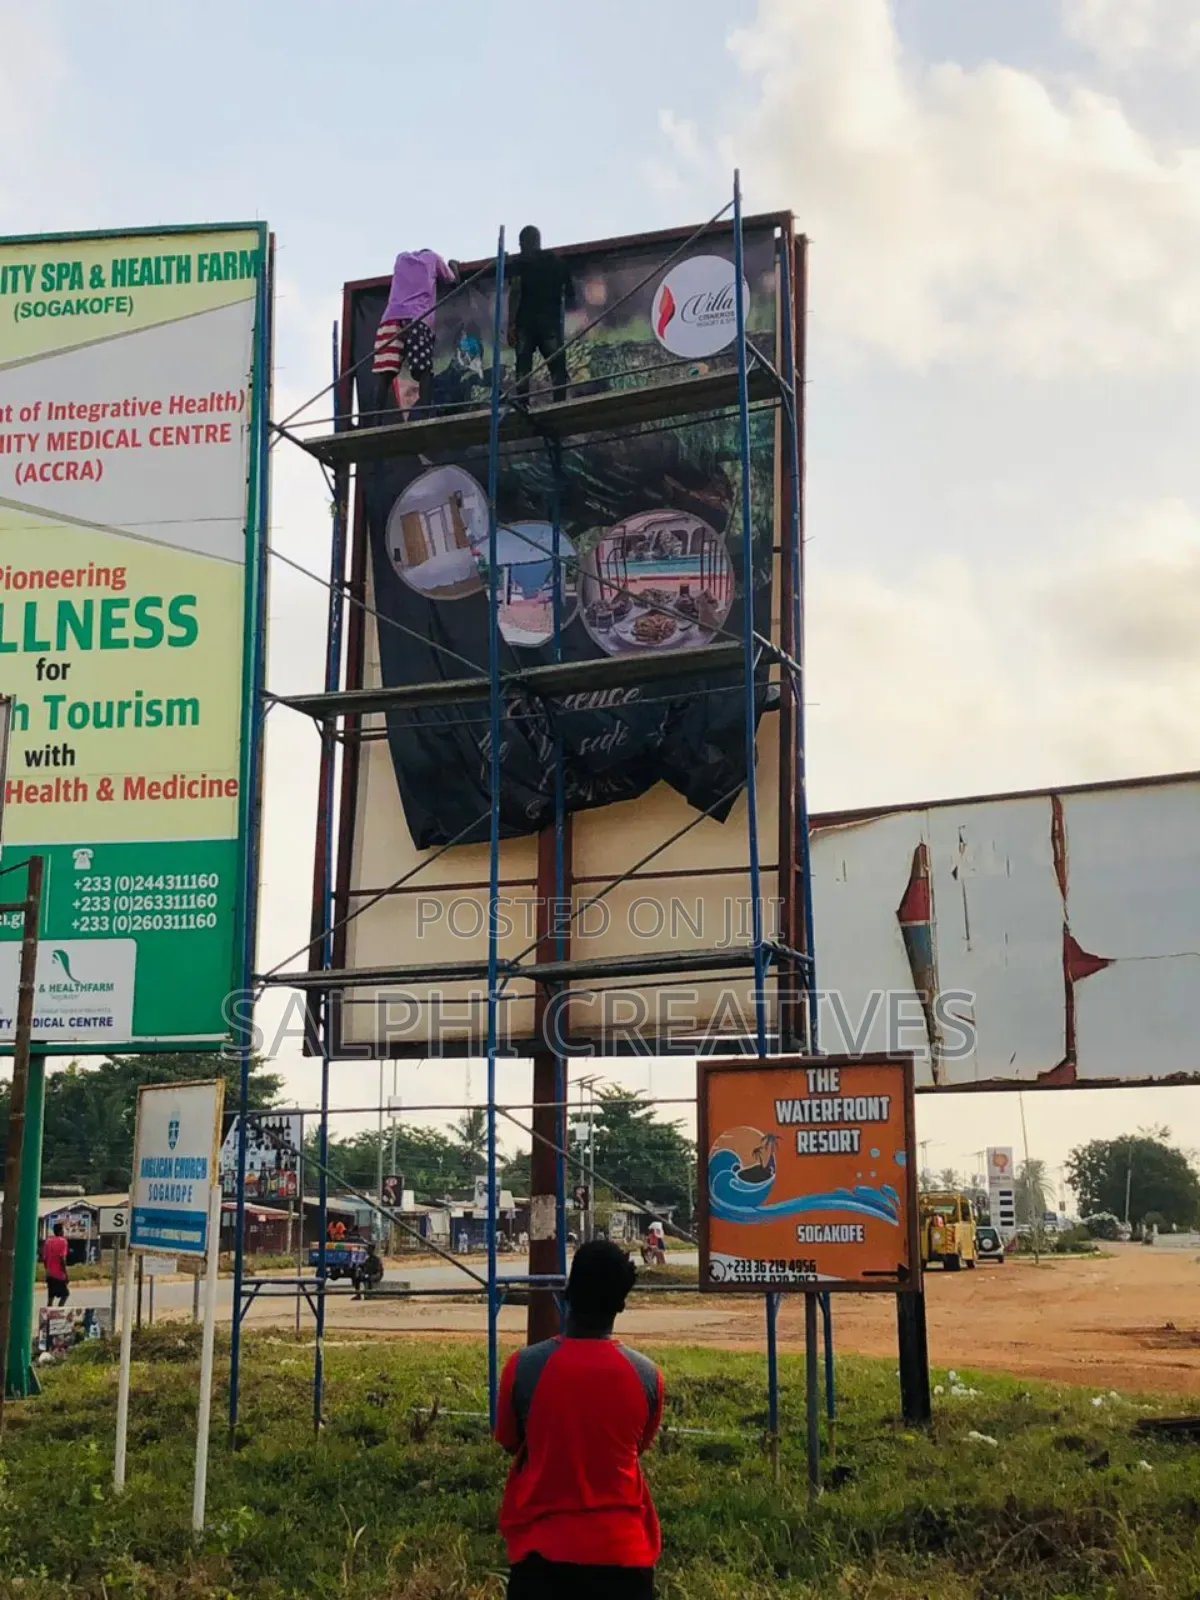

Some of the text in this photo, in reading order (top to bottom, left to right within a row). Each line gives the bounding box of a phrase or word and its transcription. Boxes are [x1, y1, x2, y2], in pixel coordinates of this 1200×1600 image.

[41, 262, 83, 292] SPA
[90, 264, 105, 289] &
[111, 254, 191, 288] HEALTH
[197, 249, 260, 282] FARM
[14, 295, 134, 322] (SOGAKOFE)
[0, 389, 245, 423] t of Integrative Health)
[47, 429, 142, 452] MEDICAL
[149, 423, 232, 445] CENTRE
[15, 459, 104, 485] (ACCRA)
[0, 562, 127, 591] ioneering
[36, 657, 71, 681] for
[43, 690, 200, 731] Tourism
[24, 743, 76, 767] with
[5, 774, 239, 804] Health & Medicine
[74, 873, 219, 894] +233 (0)244311160
[72, 893, 218, 914] +233 (0)263311160
[71, 913, 217, 934] +233 (0)260311160
[49, 982, 114, 992] HEALTHFARM
[69, 1016, 114, 1027] CENTRE
[806, 1068, 840, 1093] THE
[775, 1096, 891, 1124] WATERFRONT
[797, 1129, 861, 1154] RESORT
[797, 1224, 865, 1243] SOGAKOFE
[727, 1259, 752, 1274] +233
[753, 1259, 767, 1274] 36
